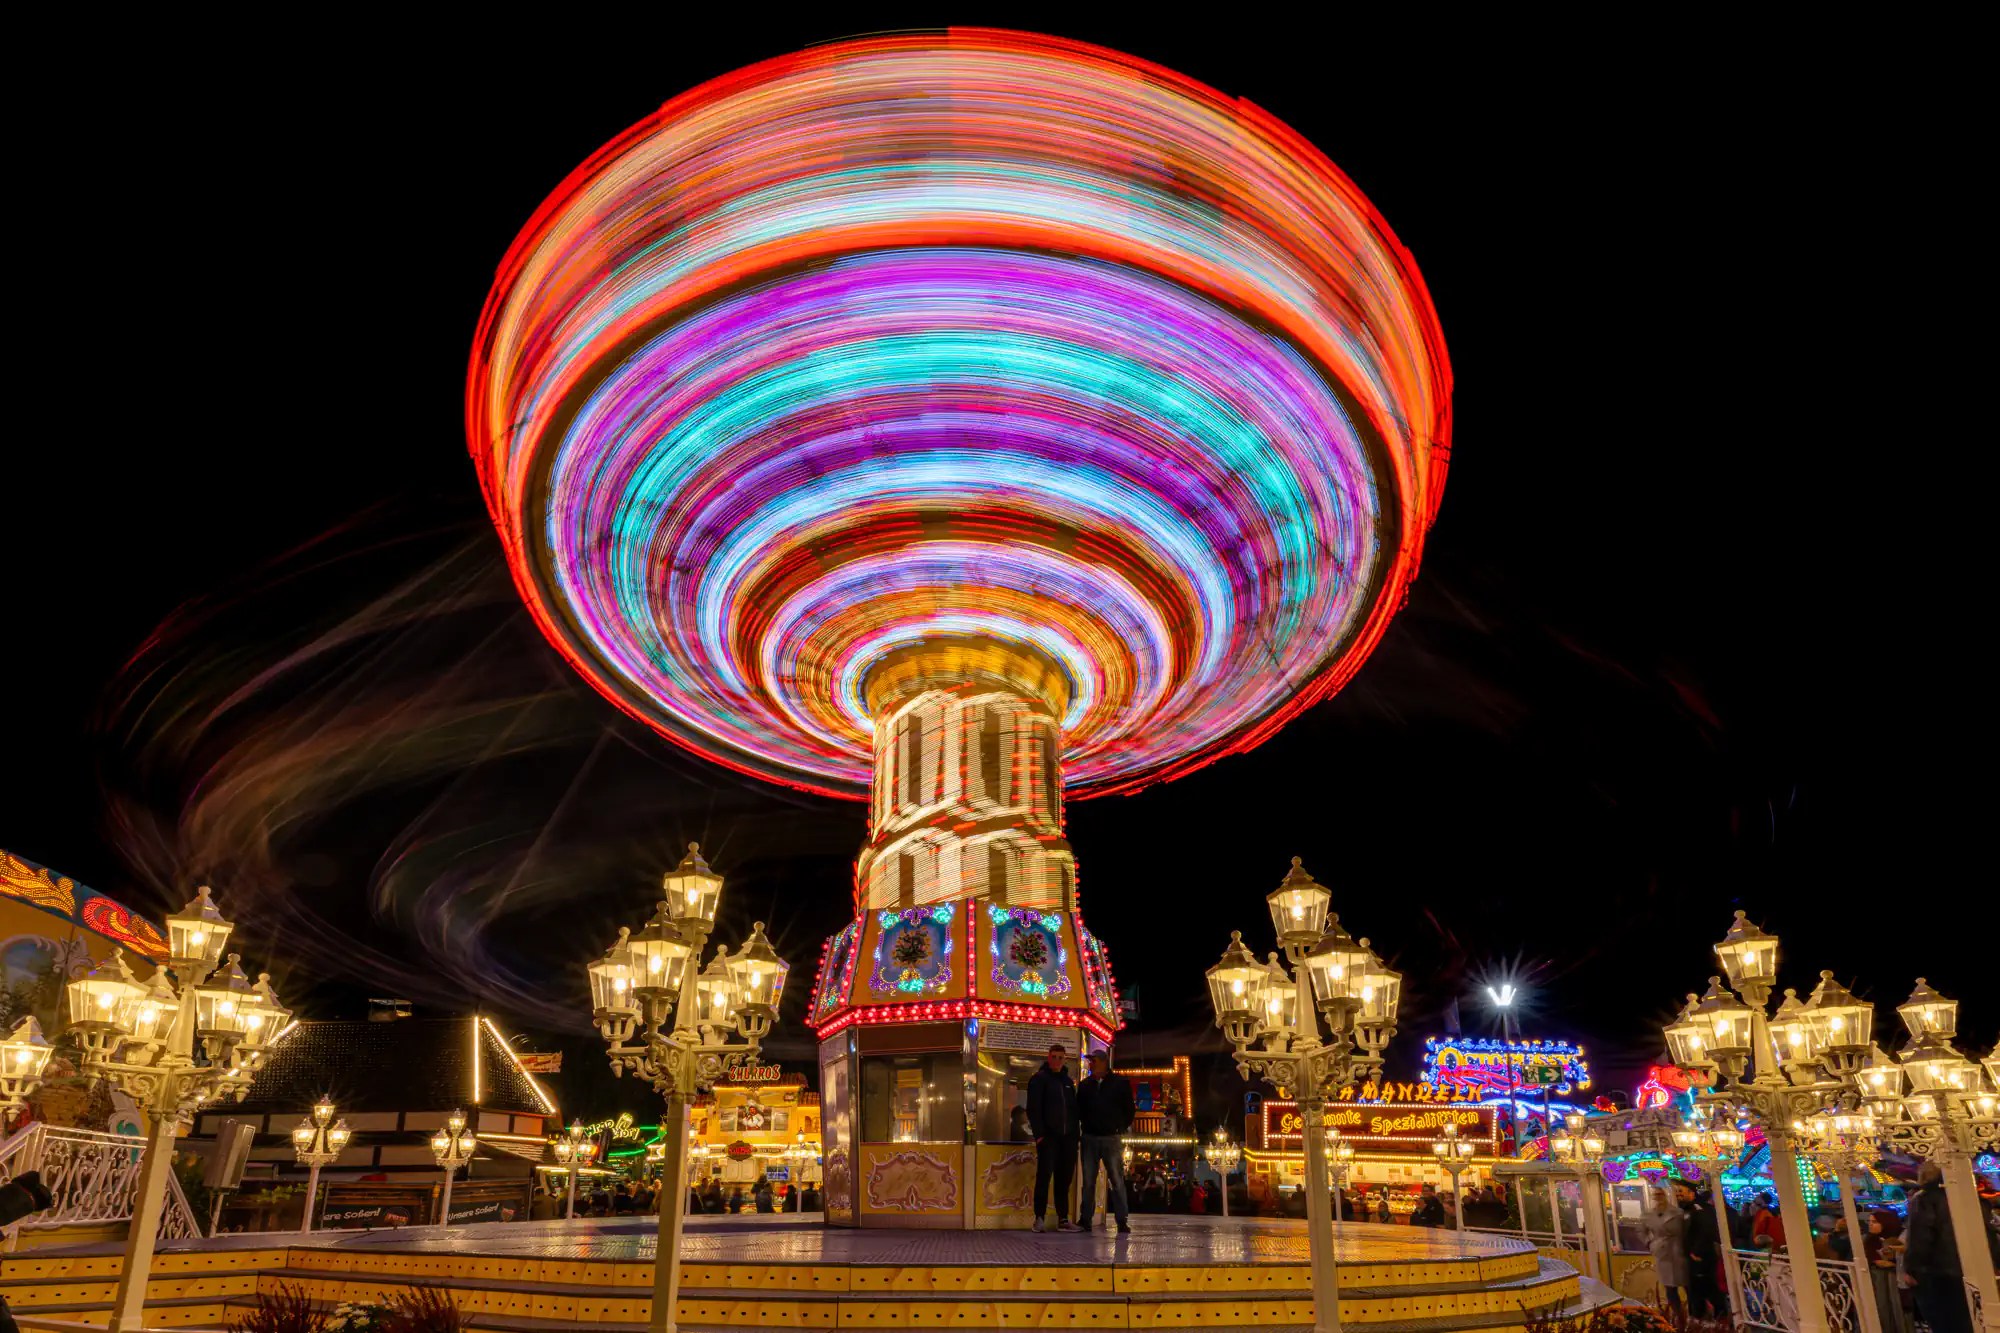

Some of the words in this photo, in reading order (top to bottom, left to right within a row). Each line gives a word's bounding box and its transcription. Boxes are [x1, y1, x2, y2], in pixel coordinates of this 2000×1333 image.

[729, 1064, 780, 1081] CHURROS
[1359, 1081, 1483, 1103] MANDELN
[1281, 1109, 1362, 1133] Gennte
[343, 1207, 380, 1218] Soßen!
[448, 1210, 474, 1220] Unsere
